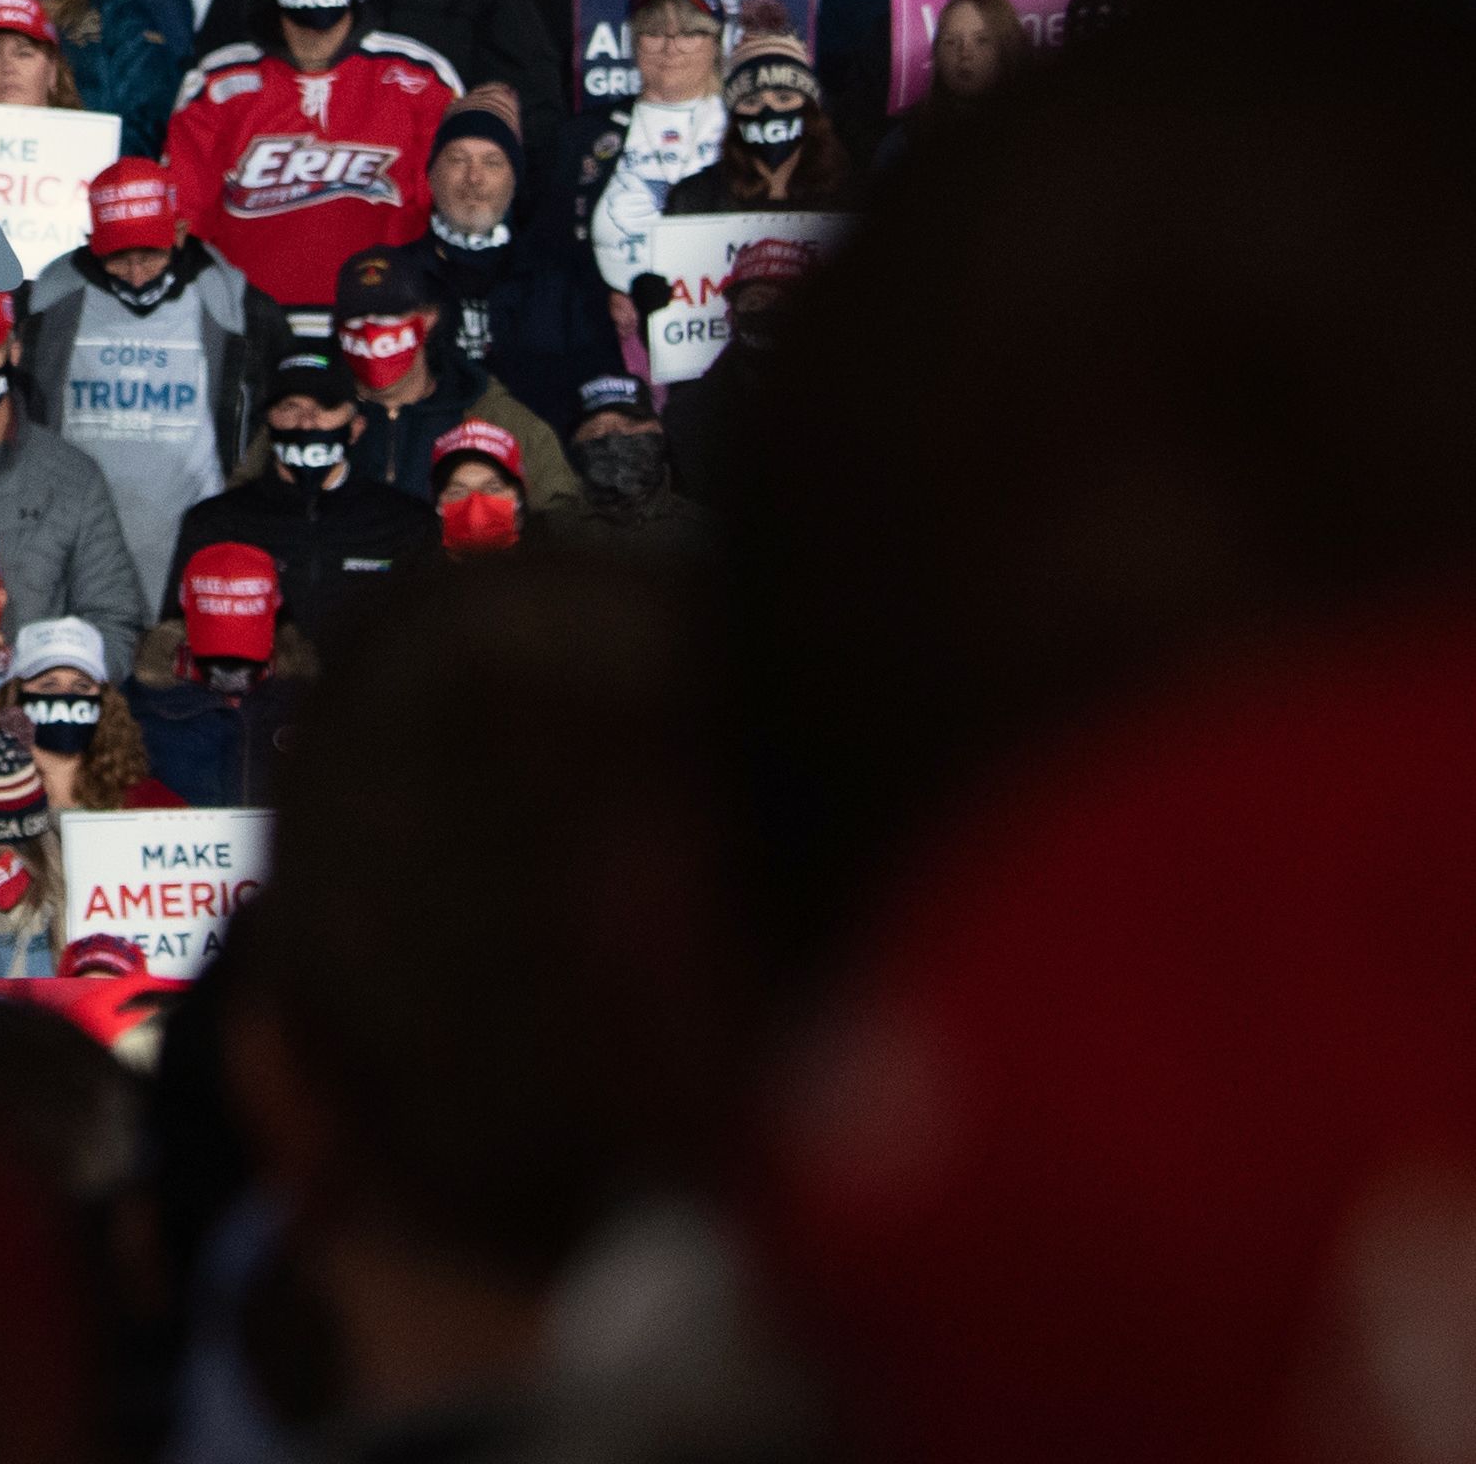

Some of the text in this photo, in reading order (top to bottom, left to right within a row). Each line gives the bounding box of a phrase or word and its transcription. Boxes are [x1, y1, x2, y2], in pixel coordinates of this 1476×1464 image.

[242, 138, 381, 187] ERIE
[342, 326, 415, 360] MAGA
[664, 317, 730, 345] GRE
[99, 346, 168, 367] COPS
[70, 380, 198, 411] TRUMP
[24, 698, 100, 724] MAGA
[141, 843, 233, 869] MAKE
[84, 880, 265, 920] AMERIC
